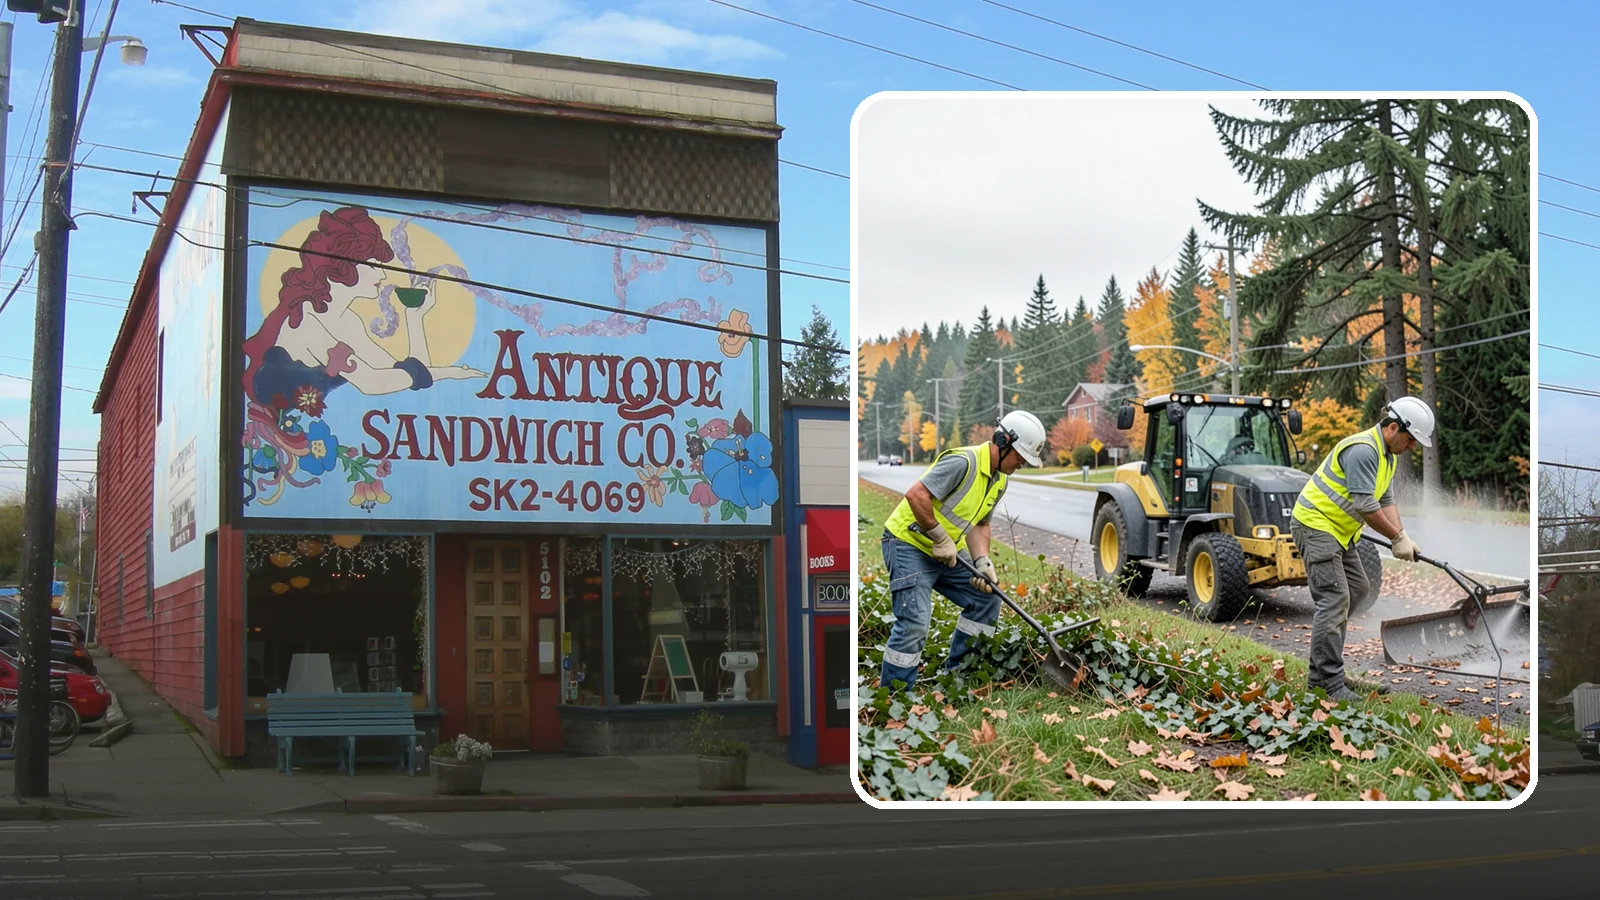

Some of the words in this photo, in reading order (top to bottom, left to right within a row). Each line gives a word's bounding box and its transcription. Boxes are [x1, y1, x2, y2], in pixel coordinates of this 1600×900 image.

[475, 329, 723, 421] ANTIQUE
[361, 408, 604, 467] SANDWICH
[616, 422, 684, 469] CO.
[467, 476, 645, 513] SK2-4069
[540, 542, 551, 599] 5102
[809, 555, 833, 568] BOOKS
